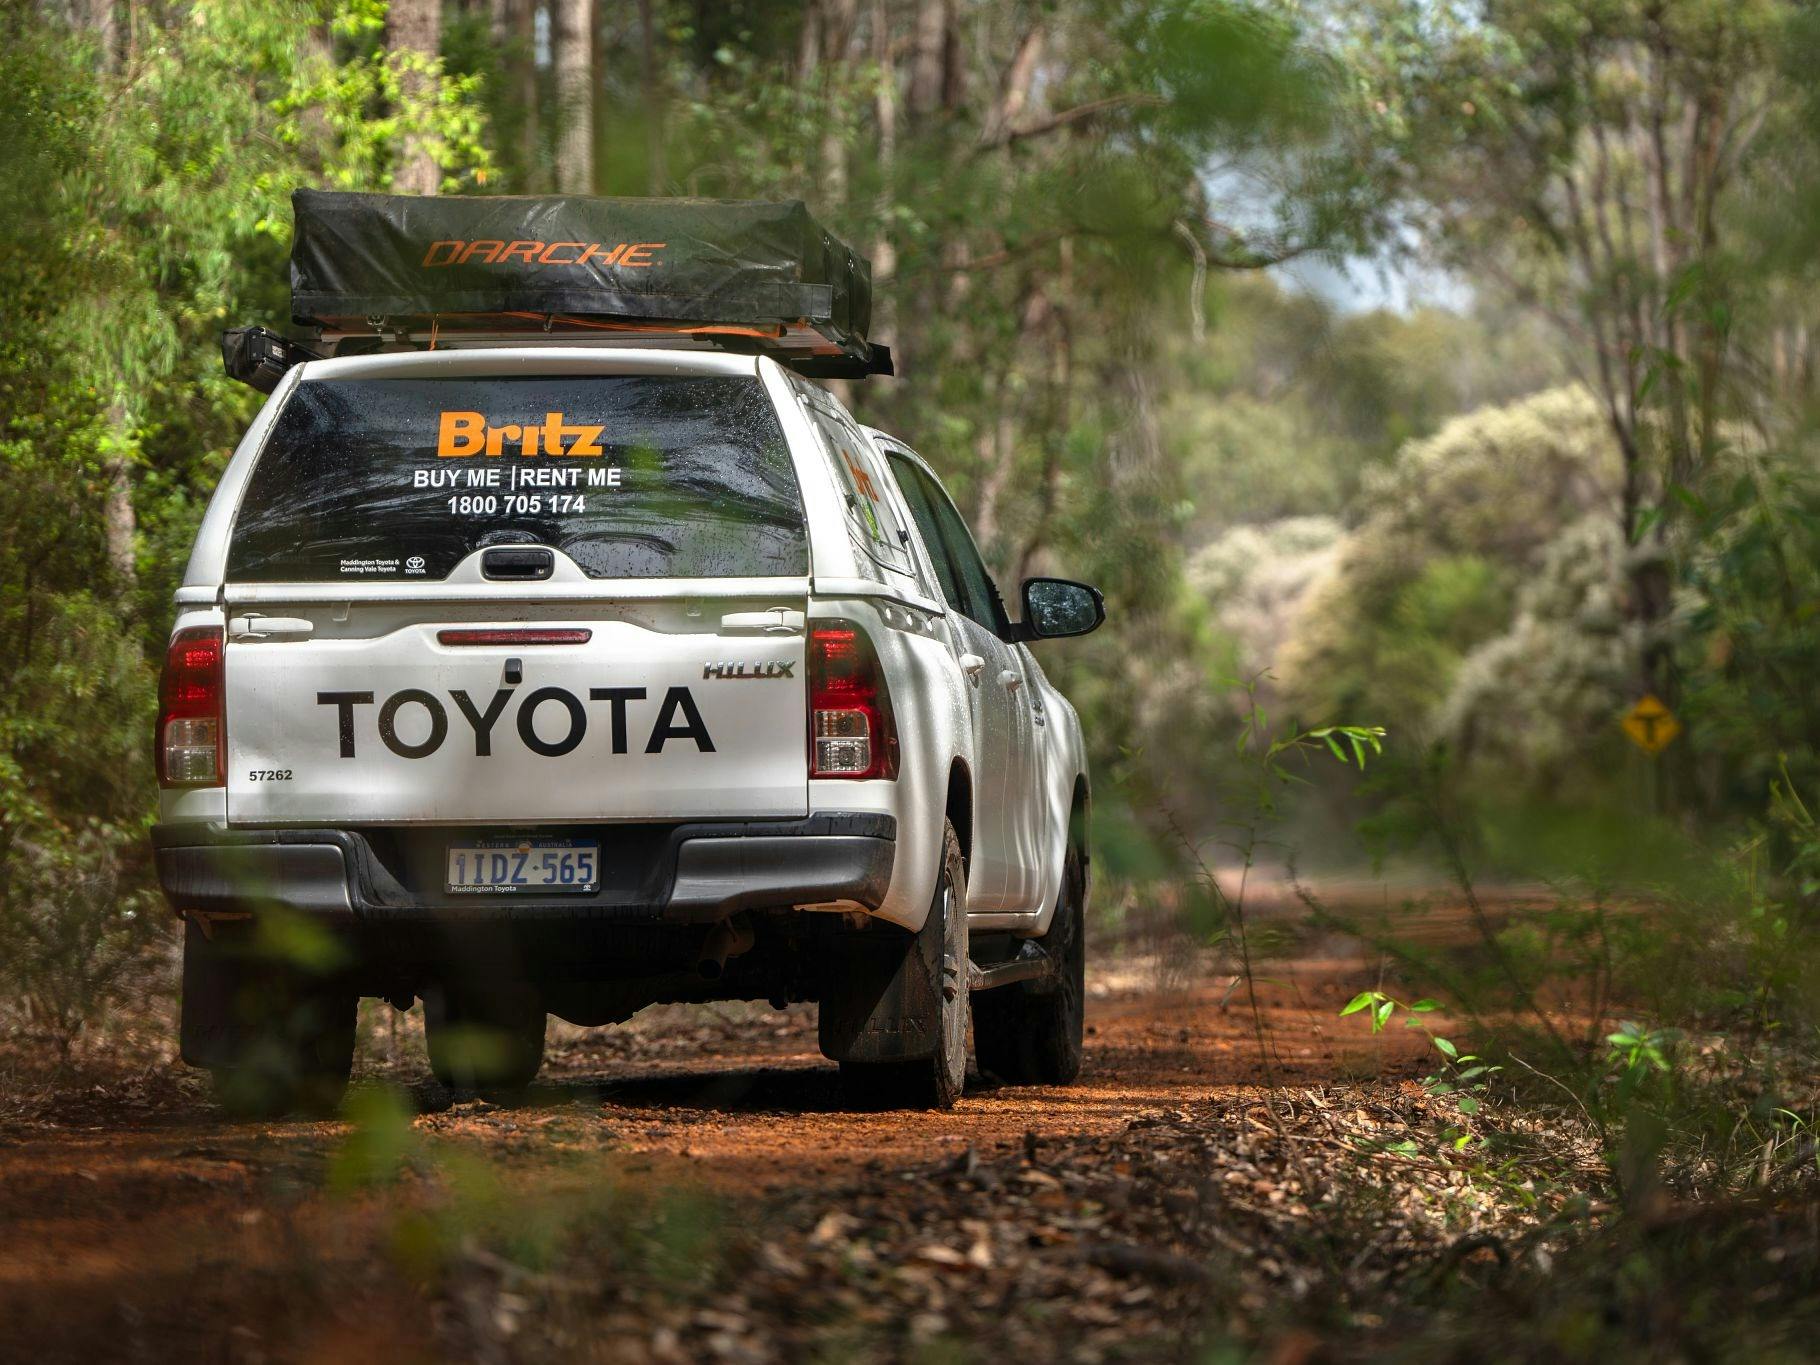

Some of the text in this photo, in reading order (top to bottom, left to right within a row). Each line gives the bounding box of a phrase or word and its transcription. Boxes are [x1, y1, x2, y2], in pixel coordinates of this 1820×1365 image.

[422, 240, 667, 267] DARCHE
[437, 411, 605, 457] Britz
[414, 469, 462, 488] BUY
[467, 469, 501, 487] ME
[520, 468, 582, 487] RENT
[588, 468, 621, 486] ME
[447, 494, 586, 514] 1800 705 174
[703, 661, 796, 680] HILUX
[317, 686, 717, 760] TOYOTA
[249, 769, 293, 781] 57262
